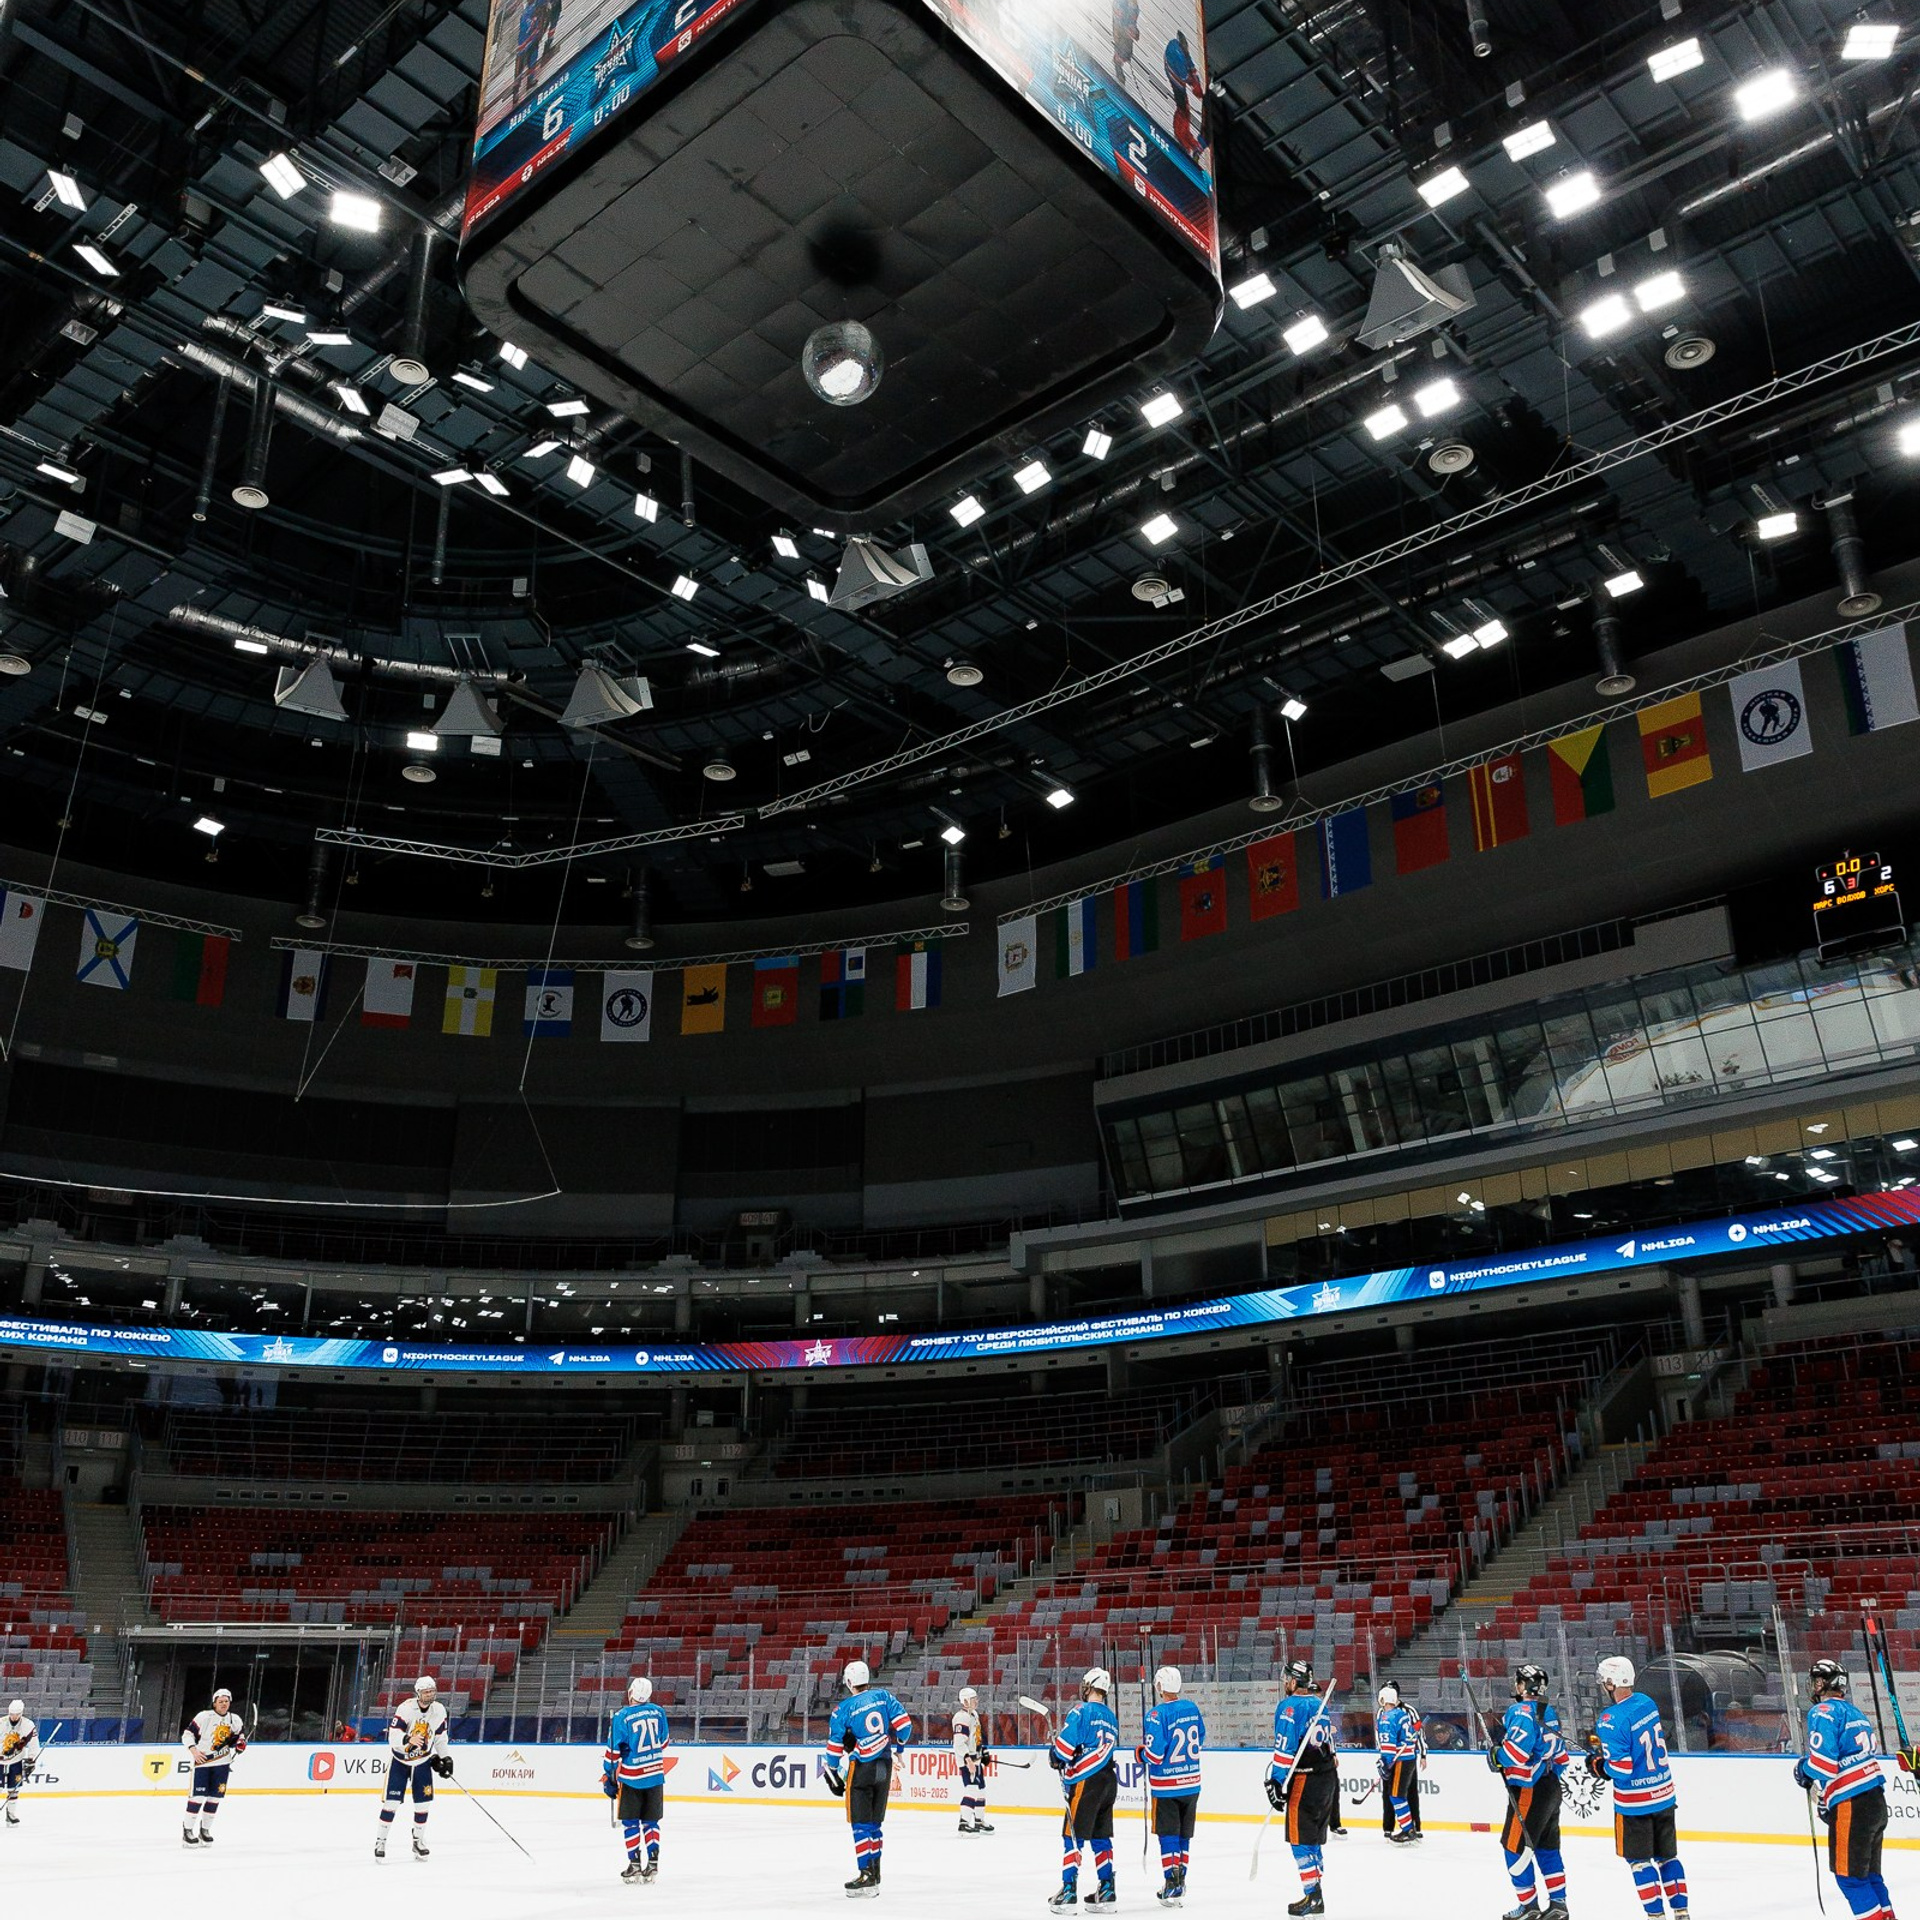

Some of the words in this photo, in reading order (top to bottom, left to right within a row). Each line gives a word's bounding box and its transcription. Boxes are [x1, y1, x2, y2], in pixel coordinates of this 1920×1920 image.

[594, 85, 630, 126] 0:00
[542, 95, 564, 140] 6
[1057, 104, 1093, 149] 0:00
[1128, 125, 1148, 174] 2
[1880, 865, 1892, 880] 2
[1824, 880, 1836, 895] 6
[1847, 877, 1856, 889] 3
[1753, 1218, 1810, 1235] NHLIGA
[1641, 1236, 1695, 1252] NHLIGA
[1450, 1253, 1587, 1282] NIGHTHOCKEYLEAGUE
[911, 1336, 960, 1347] ФОНБЕТ
[962, 1333, 985, 1343] XIV
[987, 1322, 1089, 1341] ВСЕРОССИЙСКИЙ
[1091, 1313, 1162, 1330] ФЕСТИВАЛЬ
[1164, 1311, 1181, 1321] ПО
[1183, 1304, 1231, 1318] ХОККЕЮ
[28, 1333, 88, 1345] КОМАНД
[90, 1328, 111, 1338] ПО
[113, 1331, 171, 1342] ХОККЕЮ
[976, 1339, 1017, 1351] СРЕДИ
[1018, 1330, 1113, 1348] ЛЮБИТЕЛЬСКИХ
[1115, 1323, 1164, 1337] КОМАНД
[402, 1352, 524, 1362] NIGHTHOCKEYLEAGUE
[569, 1354, 610, 1362] NHLIGA
[653, 1353, 694, 1363] NHLIGA
[1657, 1356, 1681, 1371] 113
[865, 1711, 885, 1735] 9
[632, 1718, 662, 1754] 20
[1510, 1726, 1528, 1743] 77
[1170, 1725, 1200, 1764] 28
[1639, 1722, 1669, 1772] 15
[344, 1759, 366, 1774] VK
[492, 1768, 535, 1779] БОЧКАРИ
[752, 1755, 806, 1788] сбп
